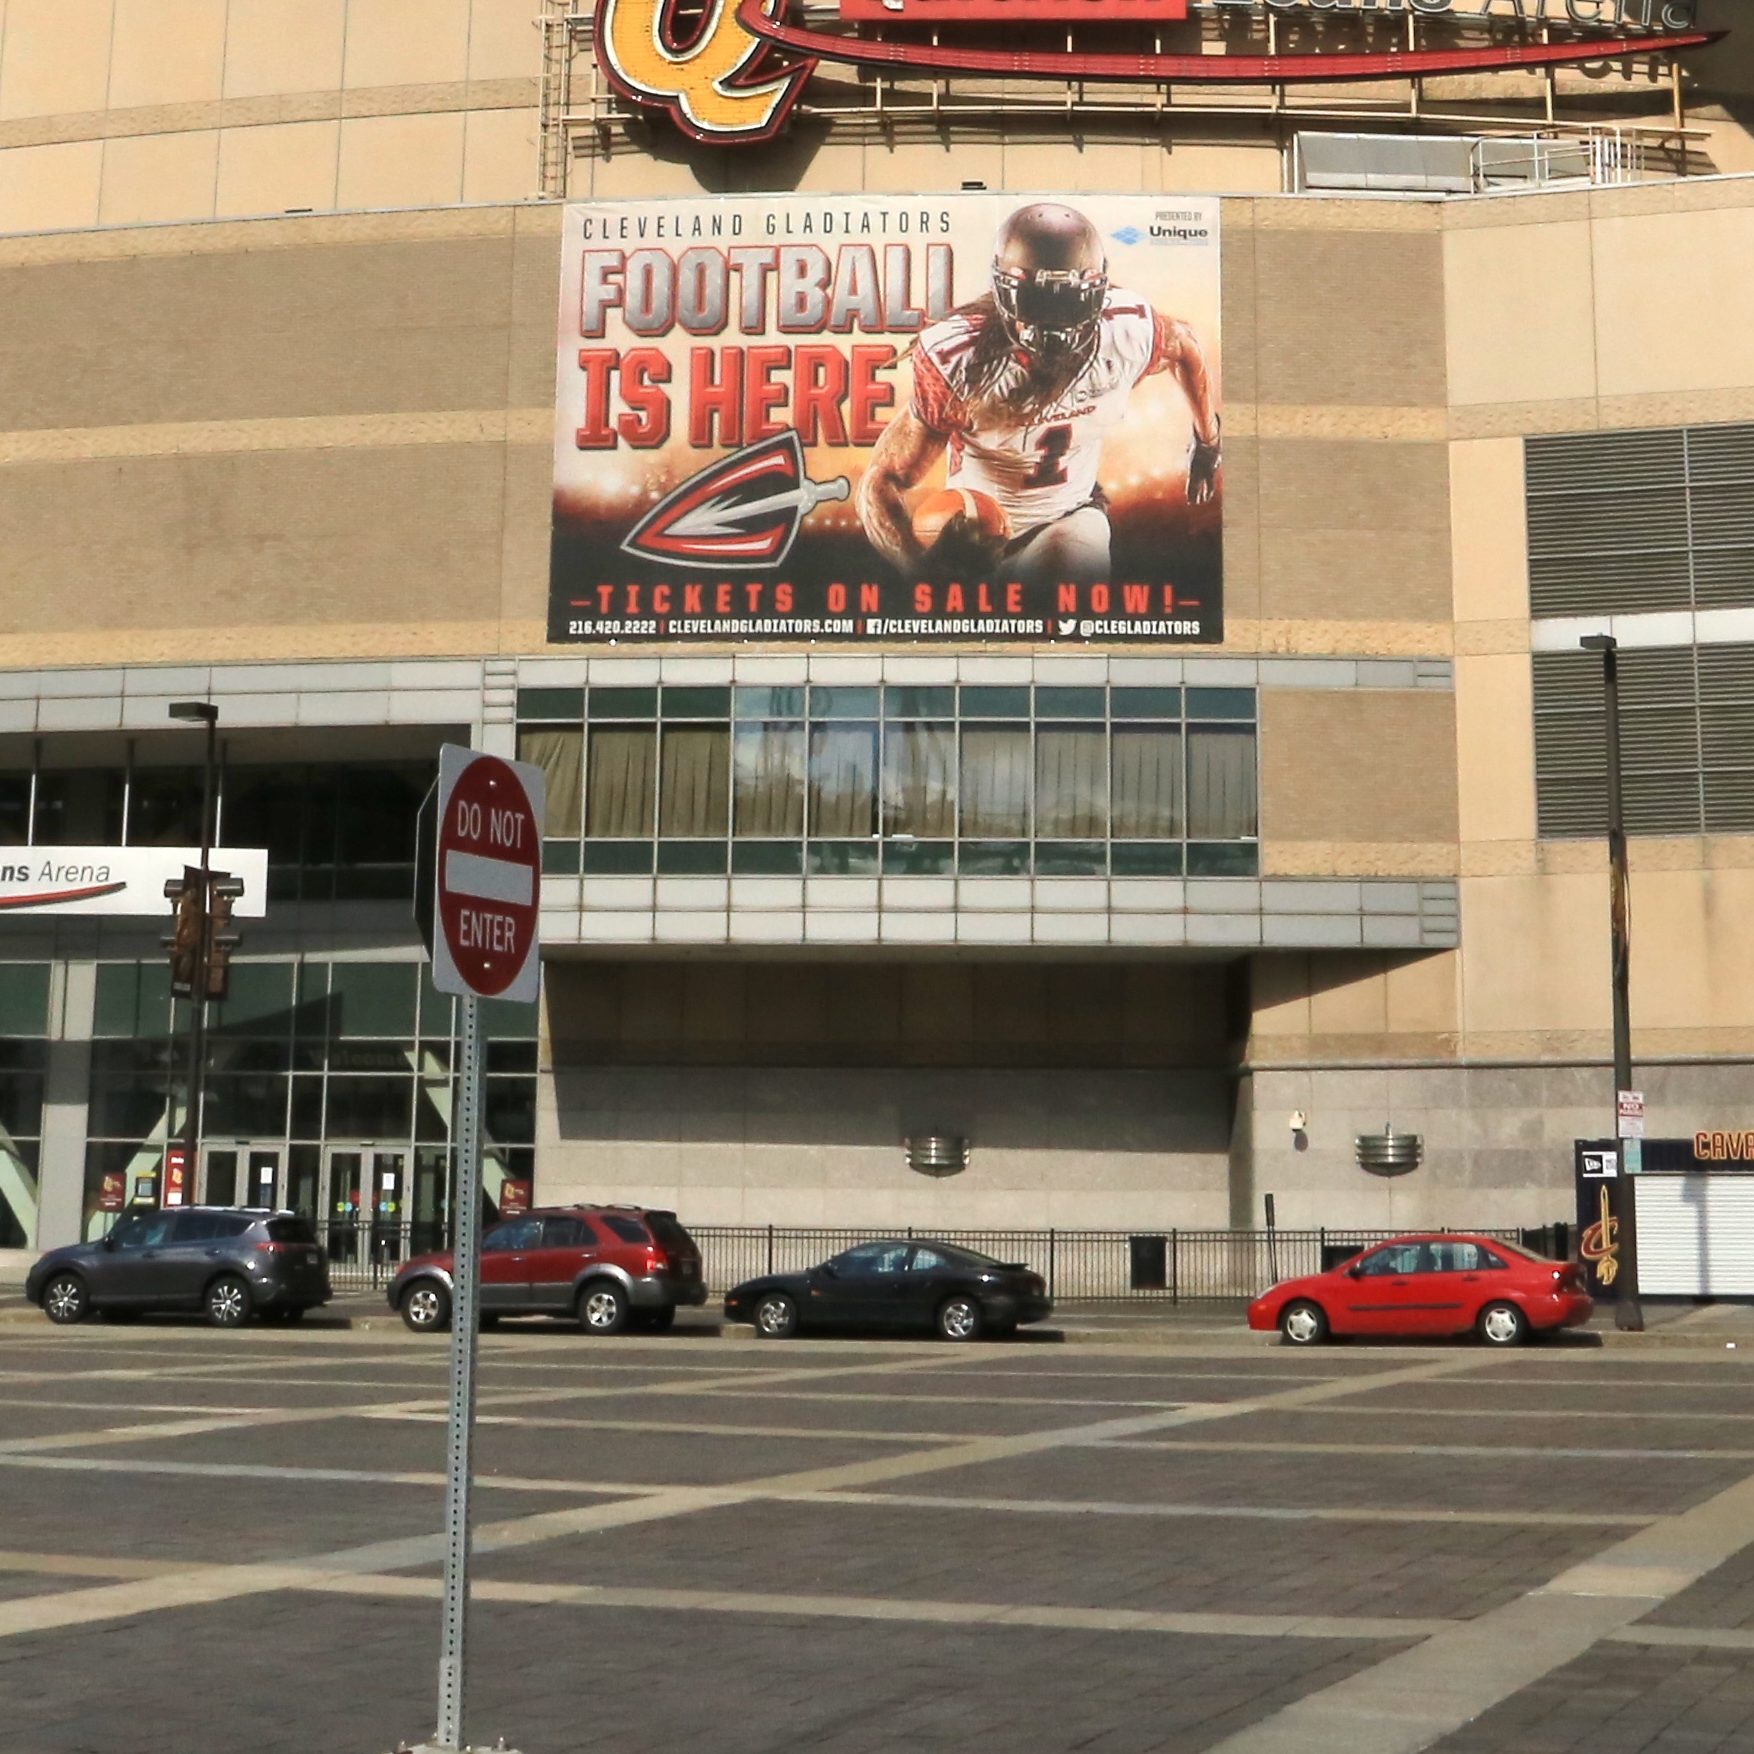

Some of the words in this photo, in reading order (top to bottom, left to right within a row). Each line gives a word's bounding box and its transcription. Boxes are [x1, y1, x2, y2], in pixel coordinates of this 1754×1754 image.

[582, 213, 743, 240] CLEVELAND
[765, 211, 952, 235] GLADIATORS
[1149, 225, 1208, 240] Unique
[579, 243, 955, 338] FOOTBALL
[576, 346, 673, 449] IS
[687, 344, 897, 449] HERE
[1022, 423, 1073, 490] 1
[596, 583, 794, 614] TICKETS
[827, 583, 879, 614] ON
[913, 583, 1023, 614] SALE
[1057, 583, 1174, 614] NOW!
[568, 619, 657, 635] 216.420.2222
[668, 618, 854, 634] CLEVELANDGLADIATORS.COM
[1079, 619, 1201, 636] @CLEGLADIATORS
[457, 799, 482, 841] DO
[489, 807, 525, 849] NOT
[37, 860, 111, 883] Arena
[459, 908, 516, 954] ENTER
